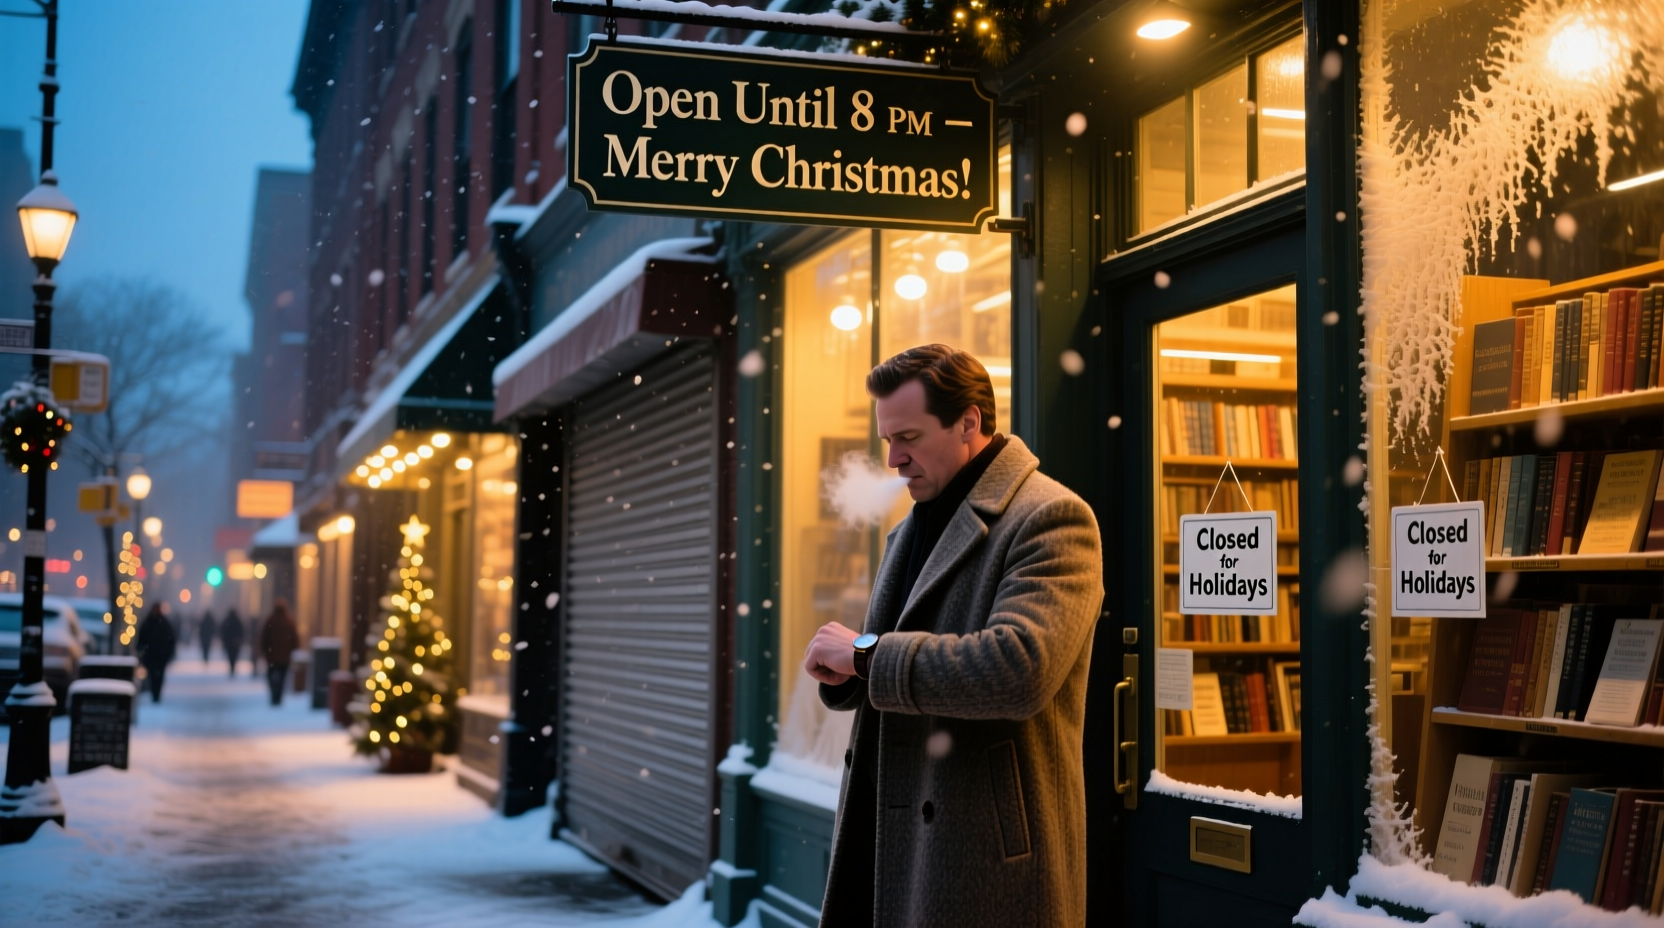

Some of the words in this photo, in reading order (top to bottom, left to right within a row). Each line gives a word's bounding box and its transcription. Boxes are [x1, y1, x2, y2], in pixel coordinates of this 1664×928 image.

[602, 70, 721, 129] Open
[732, 80, 838, 130] Until
[851, 90, 875, 132] 8
[888, 107, 933, 137] PM
[603, 134, 739, 198] Merry
[751, 144, 971, 200] Christmas!
[1196, 526, 1259, 550] Closed
[1407, 518, 1468, 544] Closed
[1219, 554, 1239, 569] for
[1428, 549, 1447, 565] for
[1189, 572, 1268, 602] Holidays
[1401, 570, 1475, 600] Holidays
